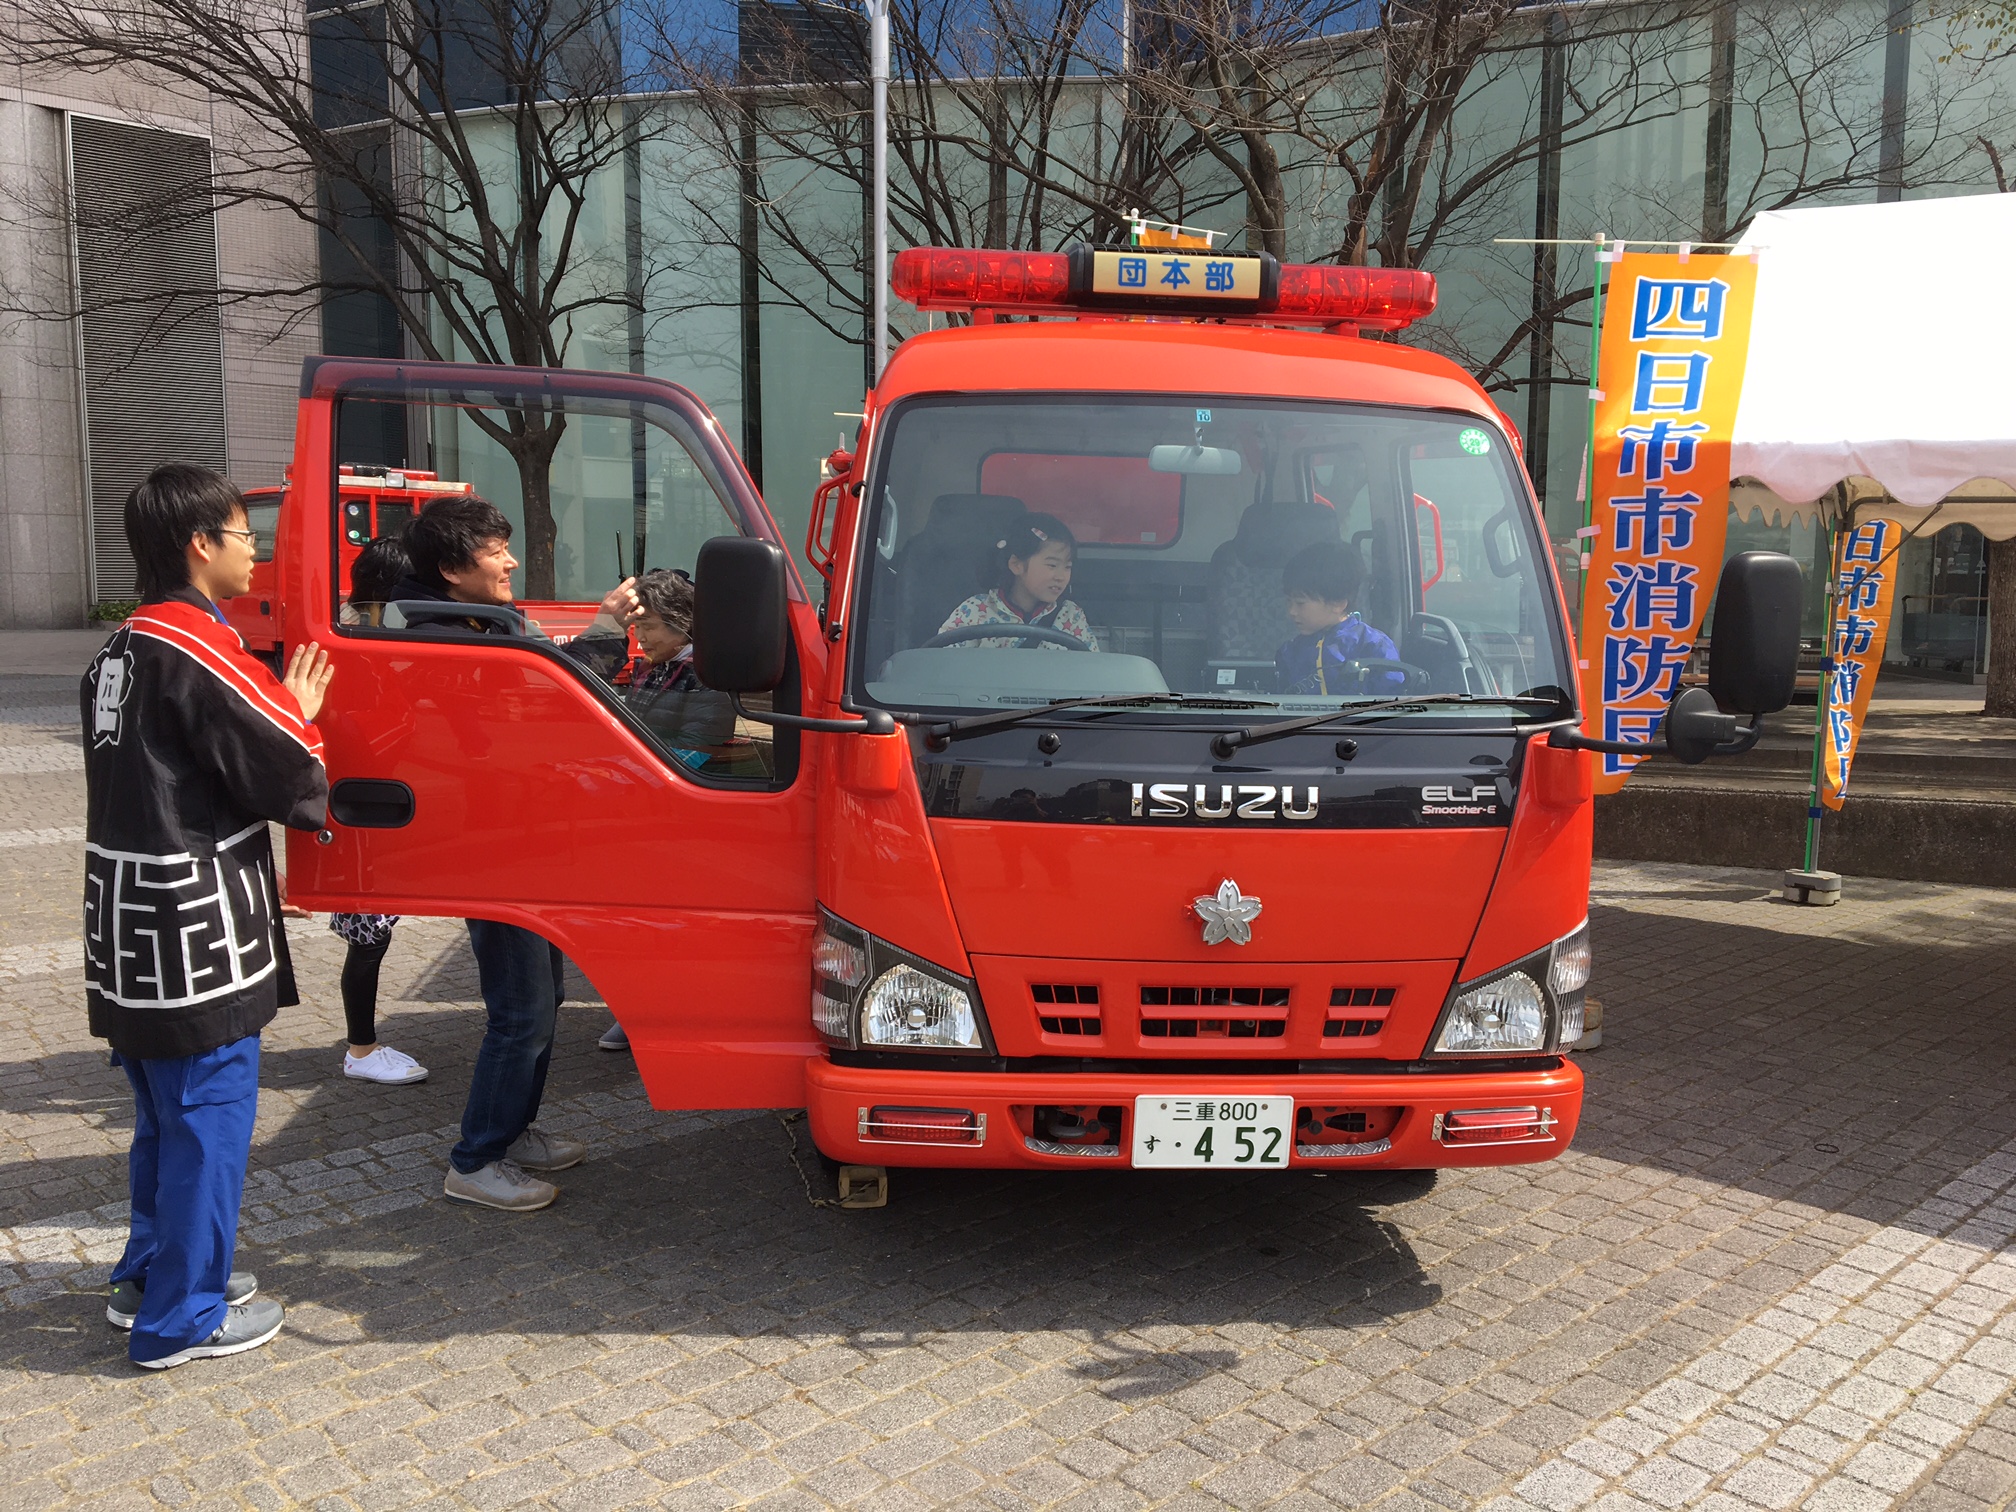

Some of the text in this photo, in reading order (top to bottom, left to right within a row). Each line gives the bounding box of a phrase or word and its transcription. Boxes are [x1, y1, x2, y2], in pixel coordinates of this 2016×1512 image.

[1117, 256, 1235, 293] 団本部
[1130, 782, 1320, 820] ISUZU
[1421, 785, 1497, 802] ELF
[1421, 805, 1497, 815] Smoother-E
